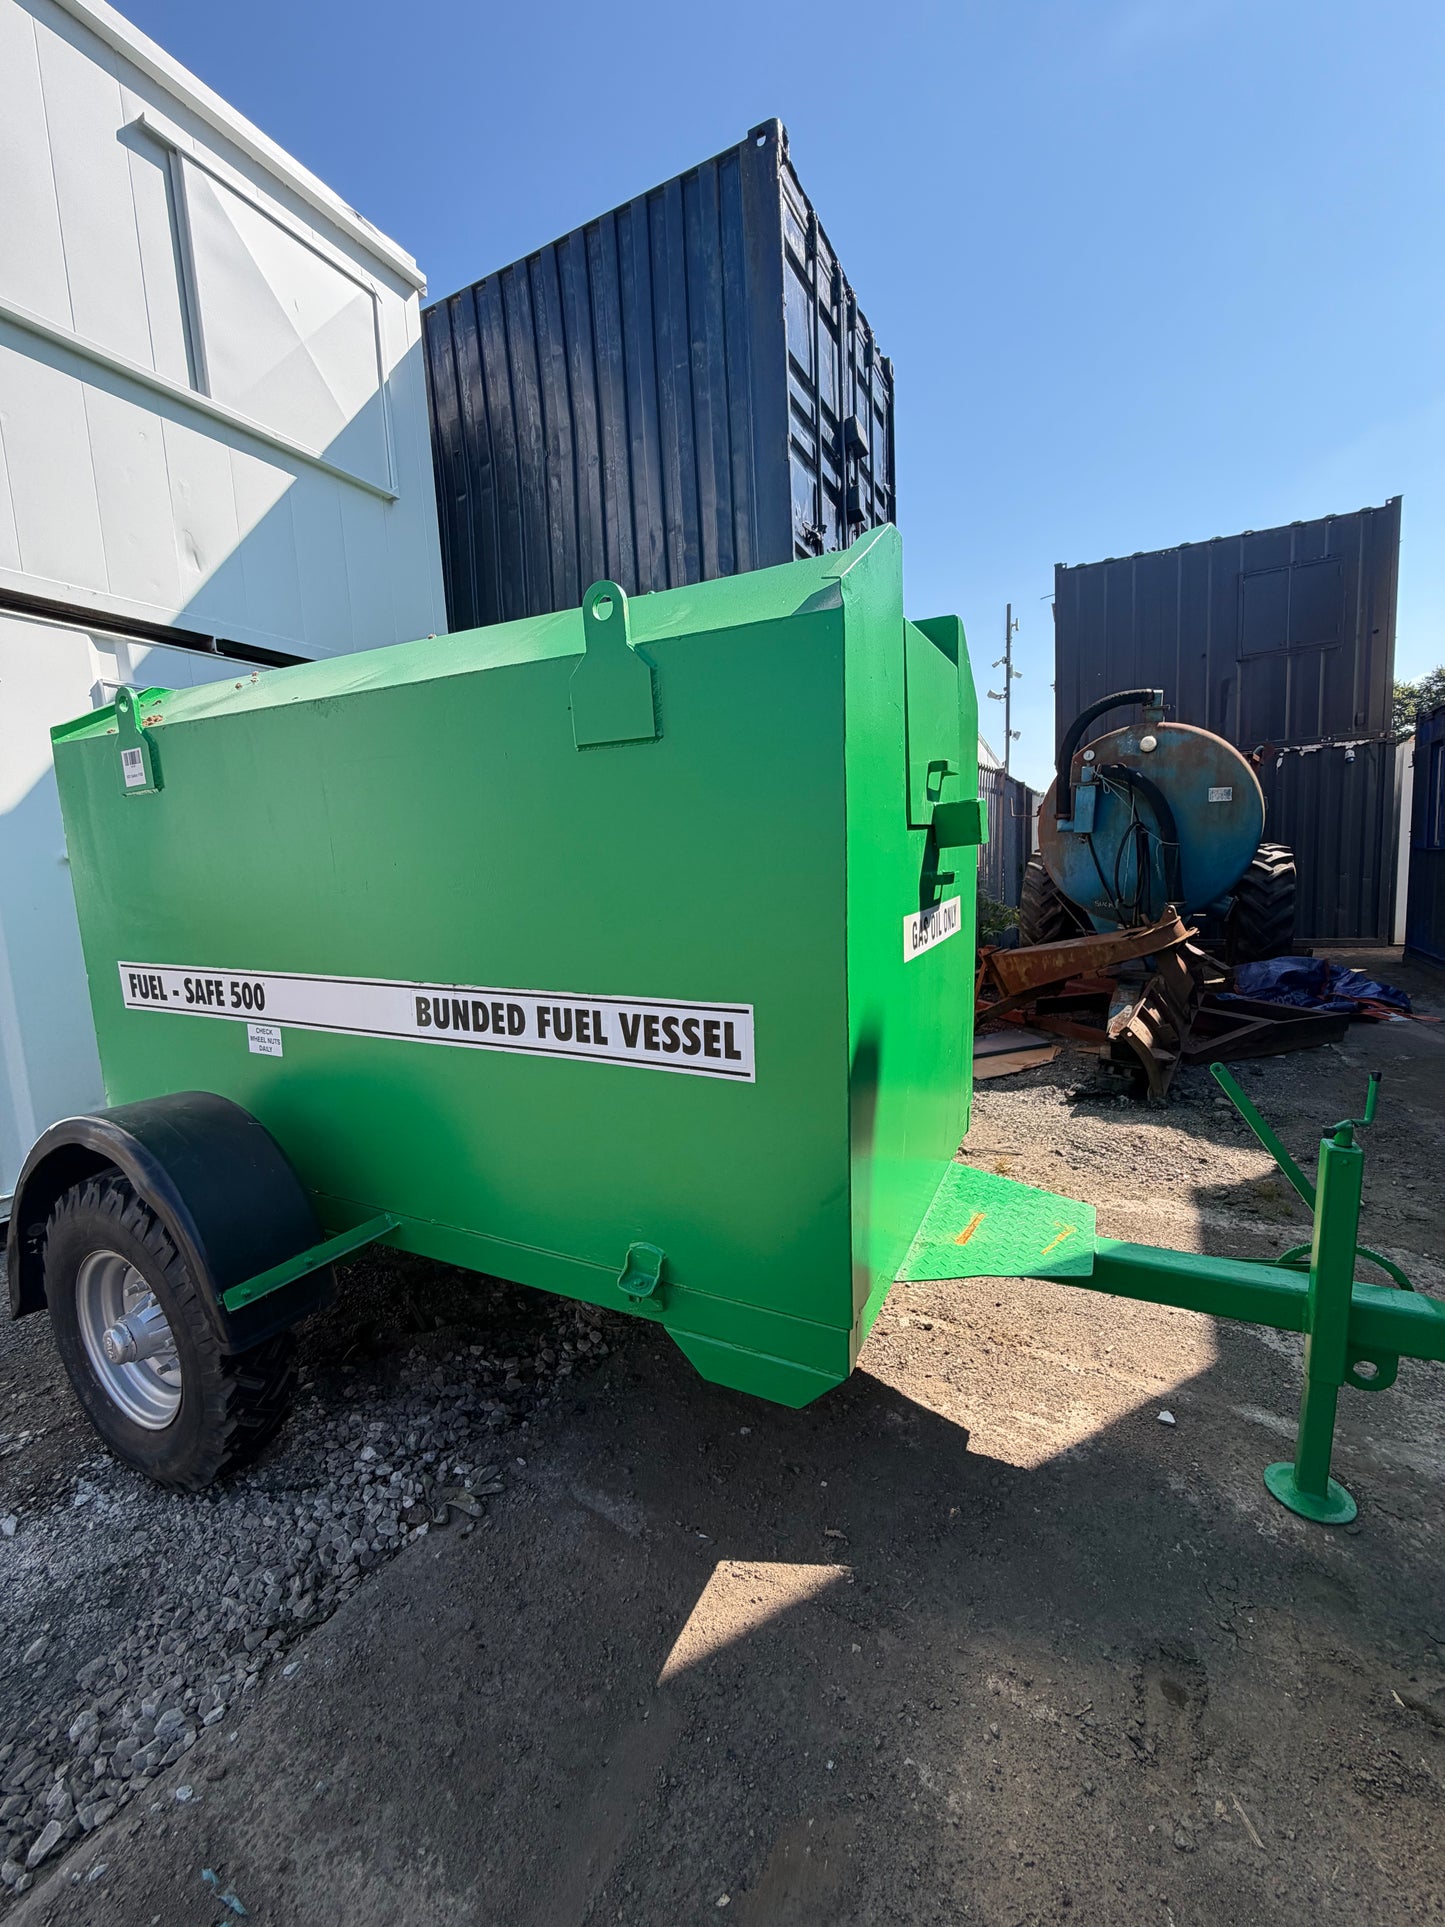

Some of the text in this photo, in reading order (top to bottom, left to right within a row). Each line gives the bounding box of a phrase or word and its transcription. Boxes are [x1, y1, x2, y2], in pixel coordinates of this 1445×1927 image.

[912, 904, 957, 950] GAS OIL ONLY
[128, 973, 168, 1001] FUEL
[183, 977, 225, 1006] SAFE
[230, 981, 265, 1011] 500
[255, 1027, 273, 1036] CHECK
[415, 996, 742, 1061] BUNDED FUEL VESSEL
[250, 1036, 280, 1046] WHEEL NUTS
[258, 1045, 273, 1053] DAILY
